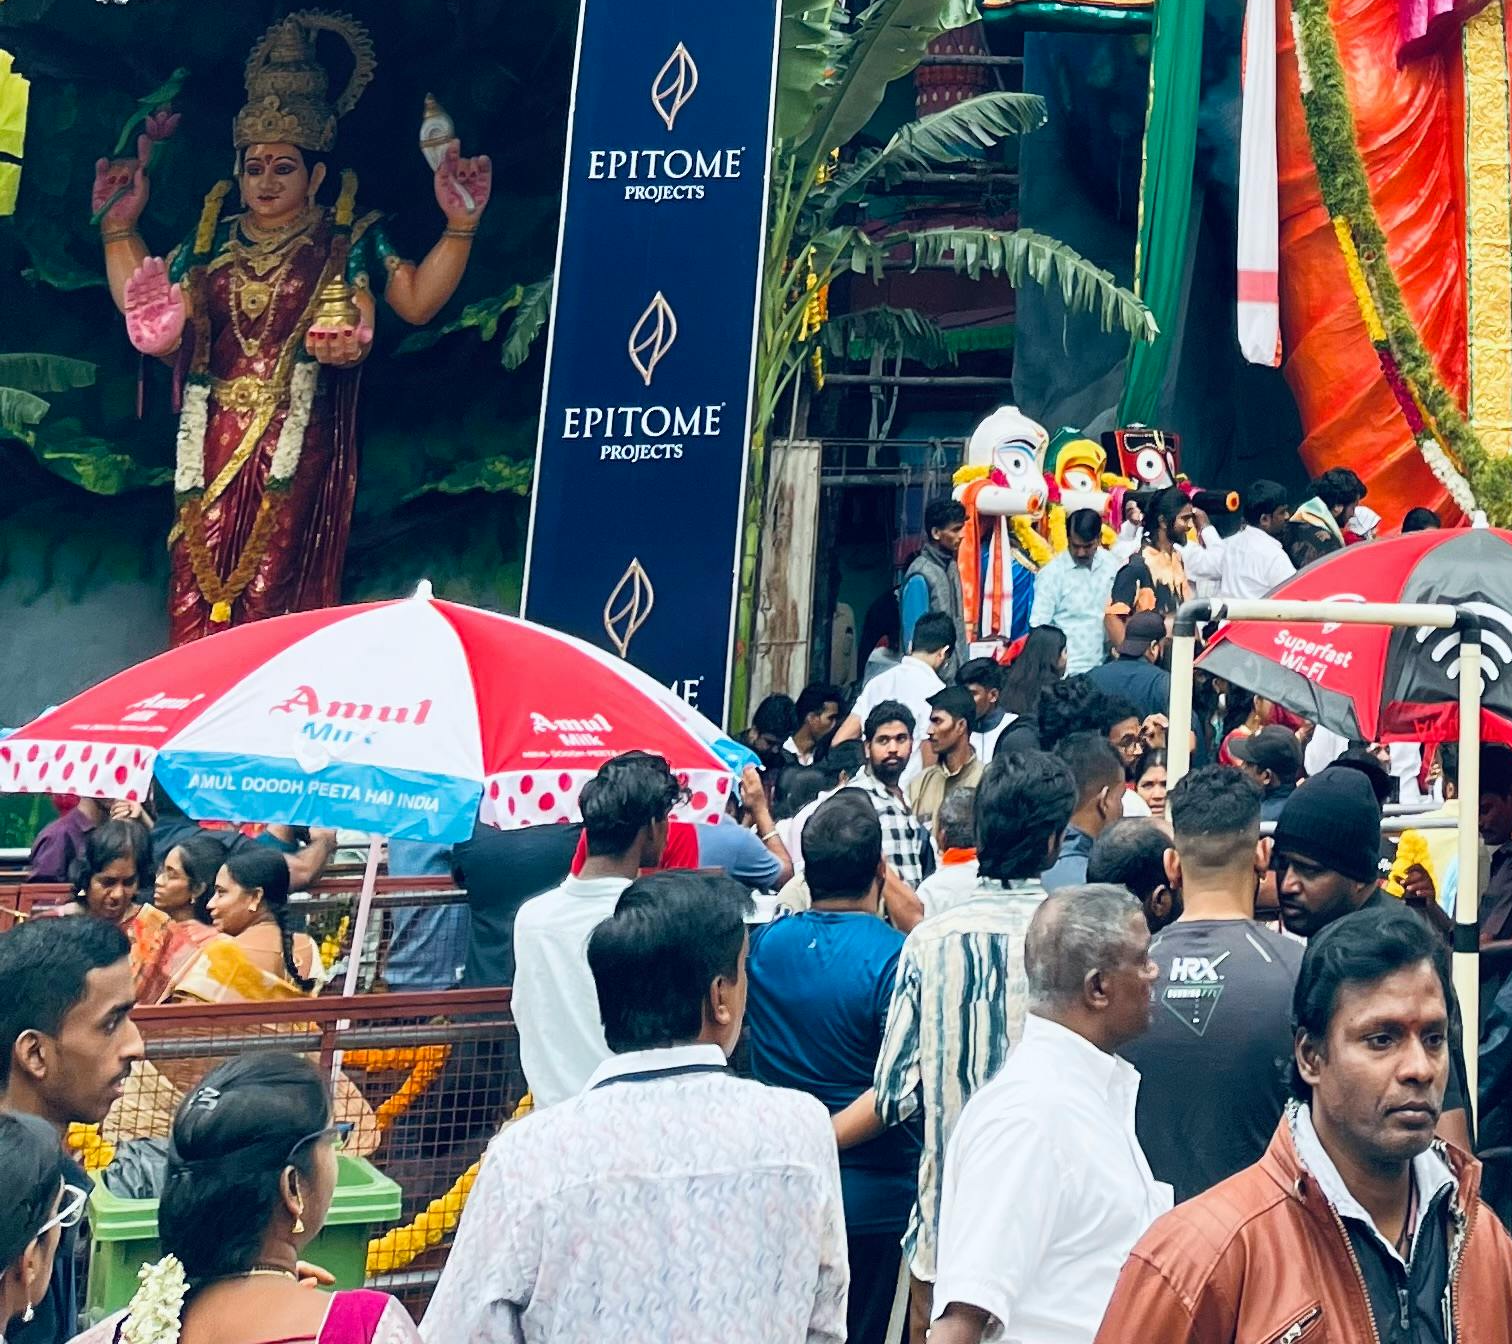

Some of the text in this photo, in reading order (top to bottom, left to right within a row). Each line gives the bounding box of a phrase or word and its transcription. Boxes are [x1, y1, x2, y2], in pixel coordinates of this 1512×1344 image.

[588, 150, 740, 178] EPITOME
[625, 185, 704, 203] PROJECTS
[1274, 629, 1353, 668] Superfast
[1281, 652, 1325, 681] Wi-Fi
[269, 686, 432, 726] Amul
[531, 712, 613, 734] Amul
[559, 734, 604, 746] Milk
[188, 774, 439, 812] AMUL DOODH PEETA HAI INDIA
[1170, 950, 1230, 981] HRX
